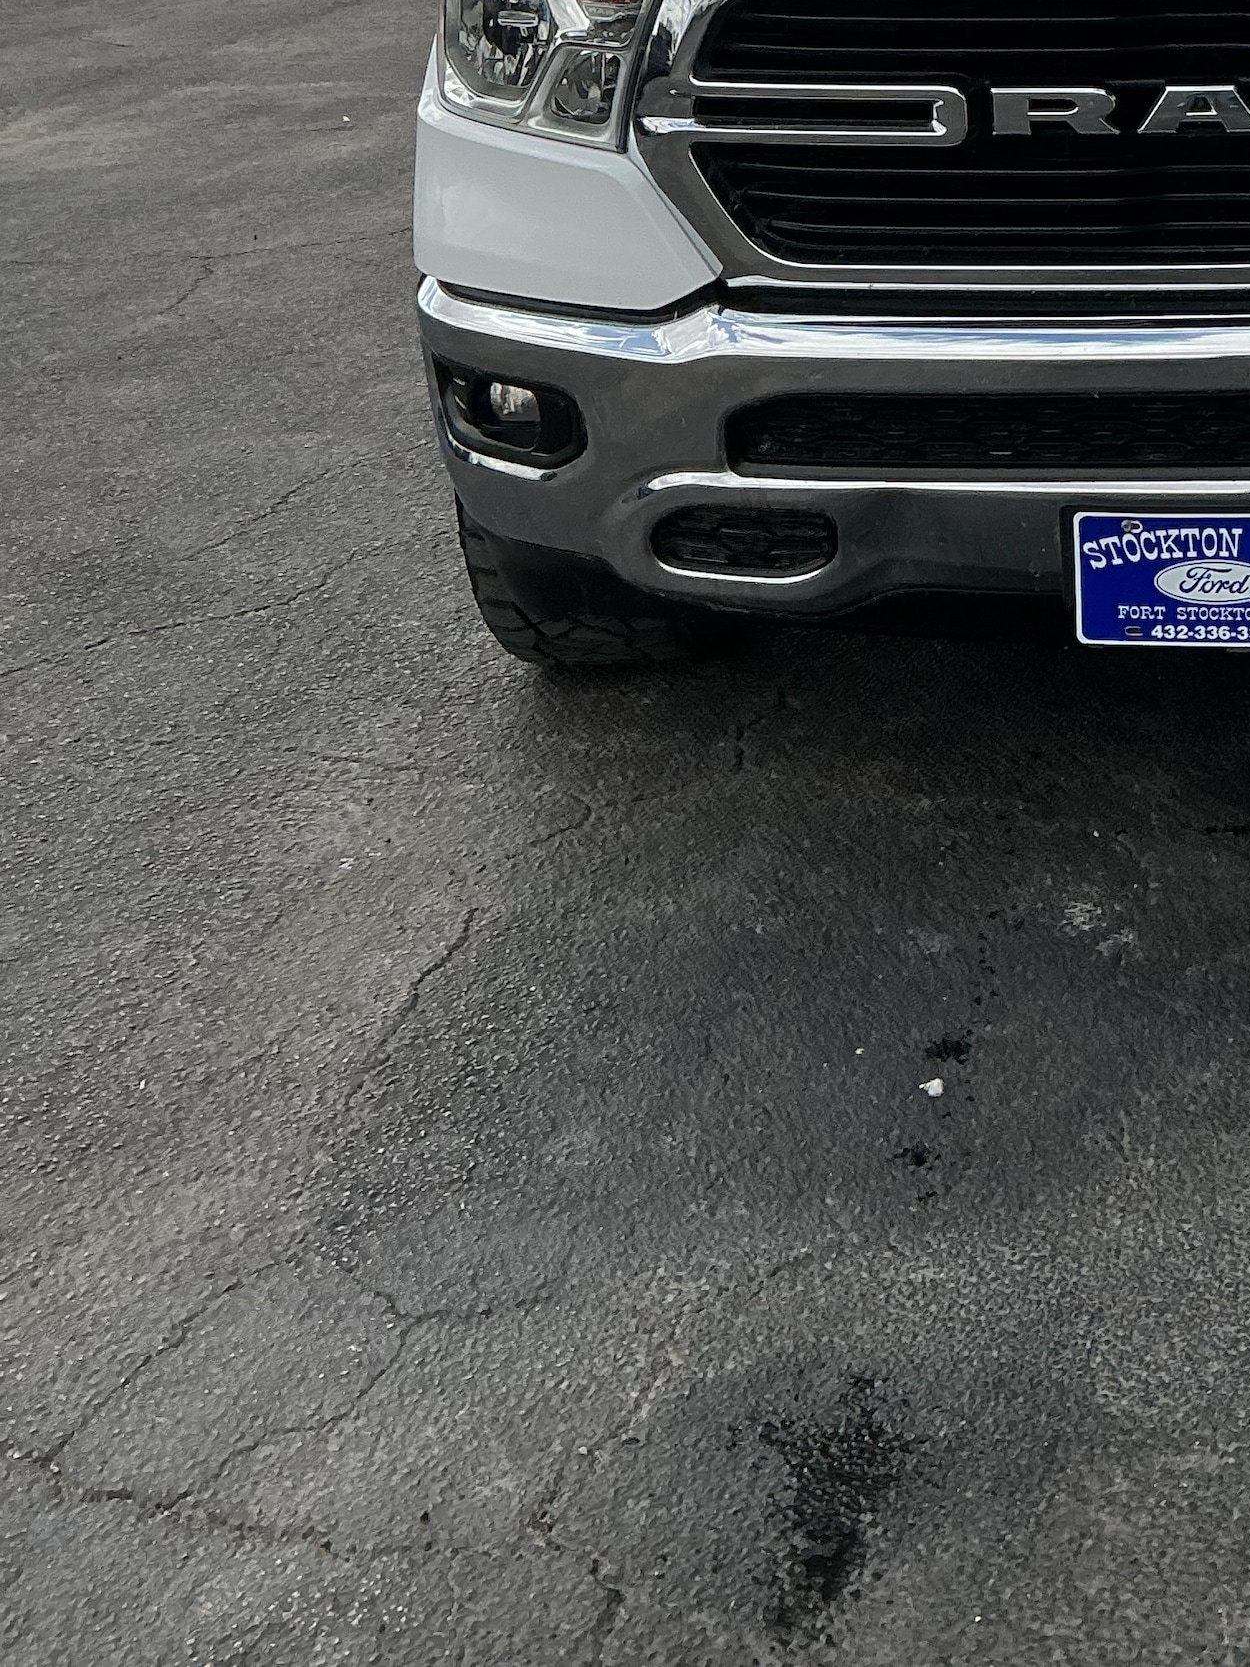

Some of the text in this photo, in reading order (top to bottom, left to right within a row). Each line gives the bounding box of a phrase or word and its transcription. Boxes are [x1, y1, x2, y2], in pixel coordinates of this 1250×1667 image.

[1083, 528, 1243, 569] STOCKTON
[1178, 566, 1250, 595] Ford
[1117, 605, 1166, 620] FORT
